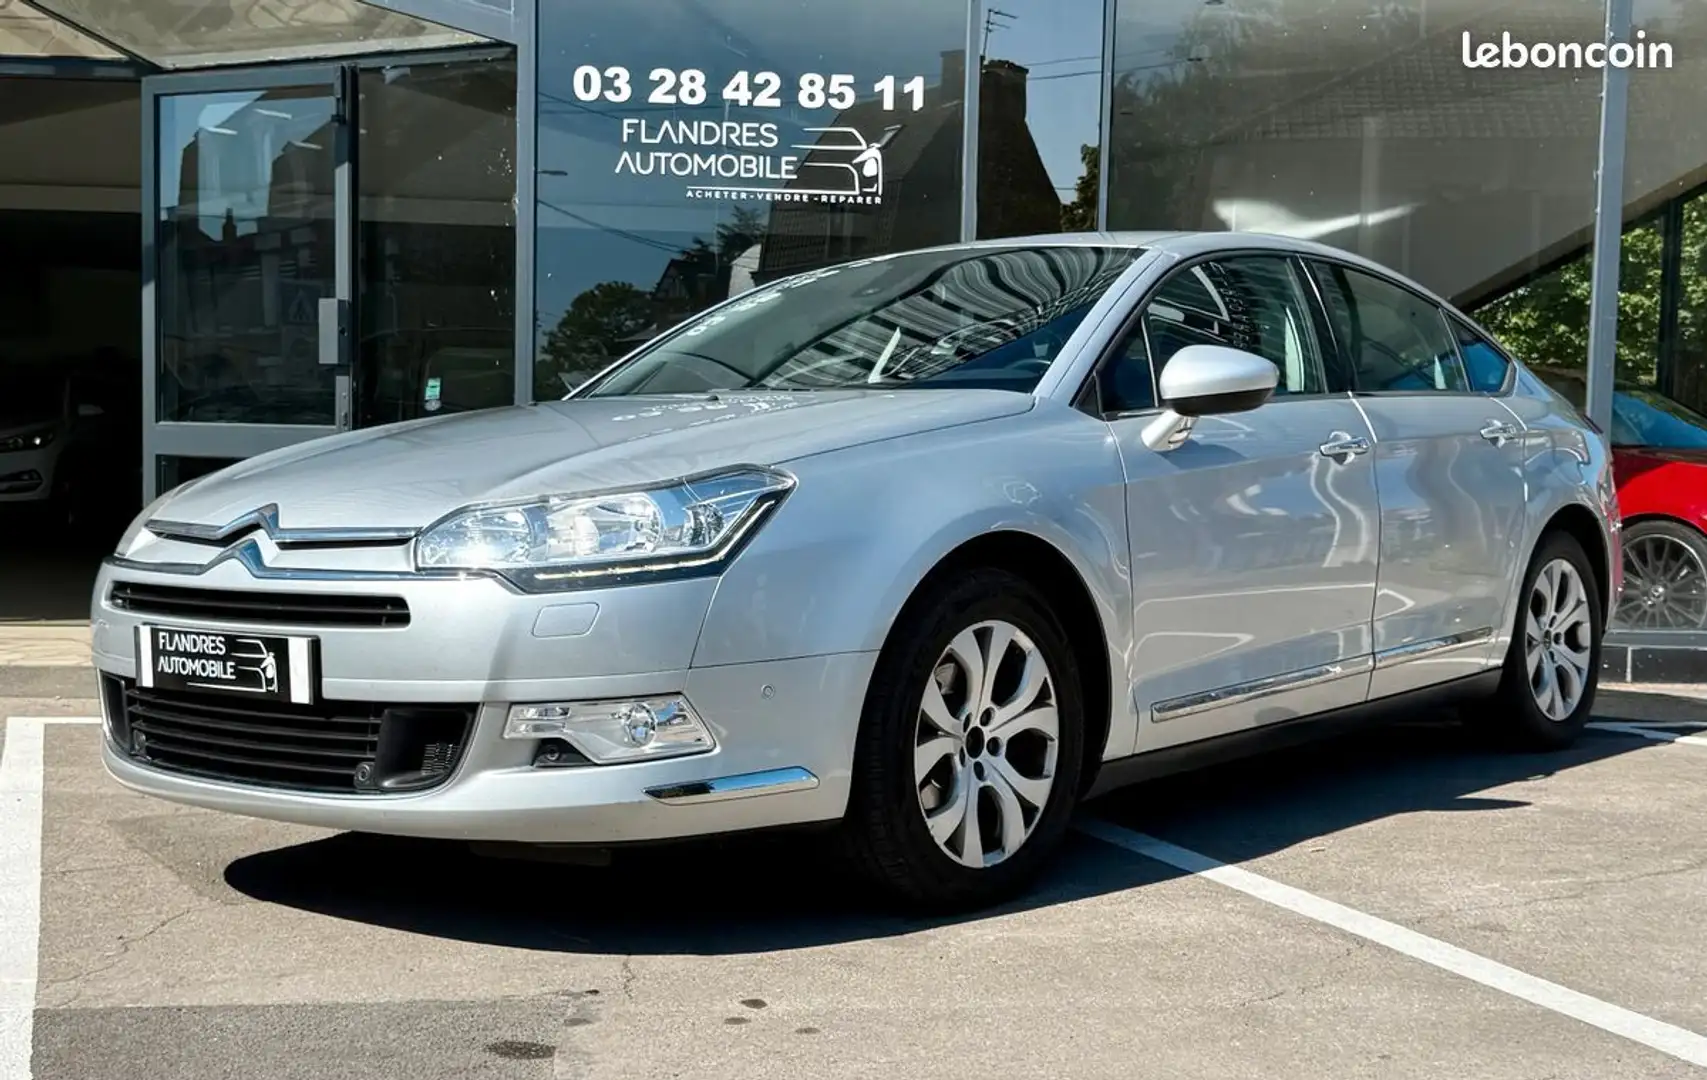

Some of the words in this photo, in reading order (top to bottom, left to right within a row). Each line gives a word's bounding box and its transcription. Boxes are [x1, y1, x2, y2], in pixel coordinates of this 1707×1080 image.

[573, 65, 632, 102] 03
[648, 68, 706, 105] 28
[722, 71, 781, 107] 42
[798, 73, 855, 110] 85
[873, 75, 925, 112] 11
[622, 118, 778, 148] FLANDRES
[615, 151, 798, 180] AUTOMOBILE
[158, 632, 226, 655] FLANDRES
[157, 655, 237, 680] AUTOMOBILE
